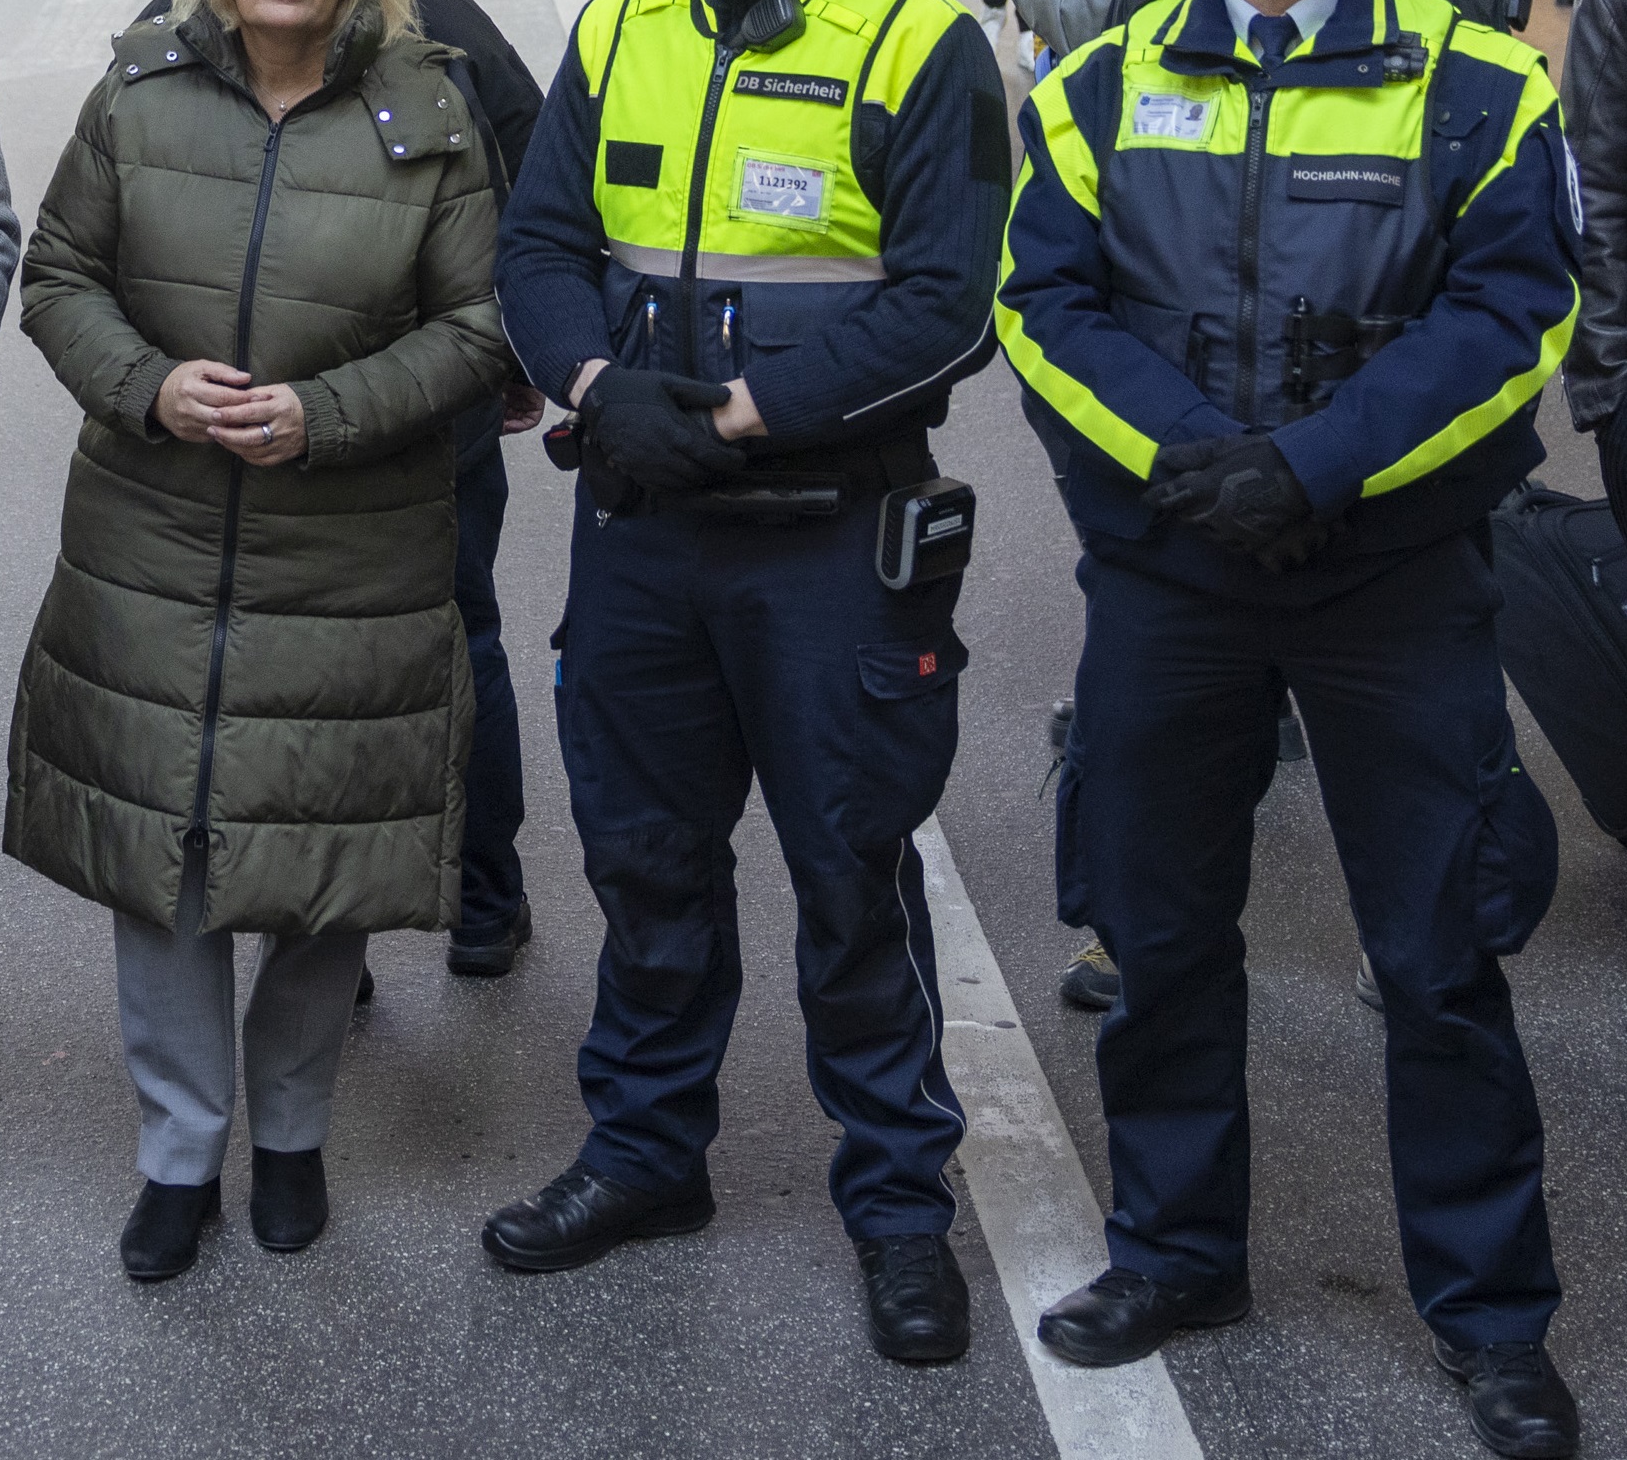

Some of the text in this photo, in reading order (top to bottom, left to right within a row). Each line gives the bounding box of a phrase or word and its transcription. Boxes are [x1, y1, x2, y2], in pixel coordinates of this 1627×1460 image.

[737, 75, 844, 102] DB Sicherheit
[759, 175, 808, 191] 1121392
[1292, 169, 1401, 188] HOCHBAHN-WACHE
